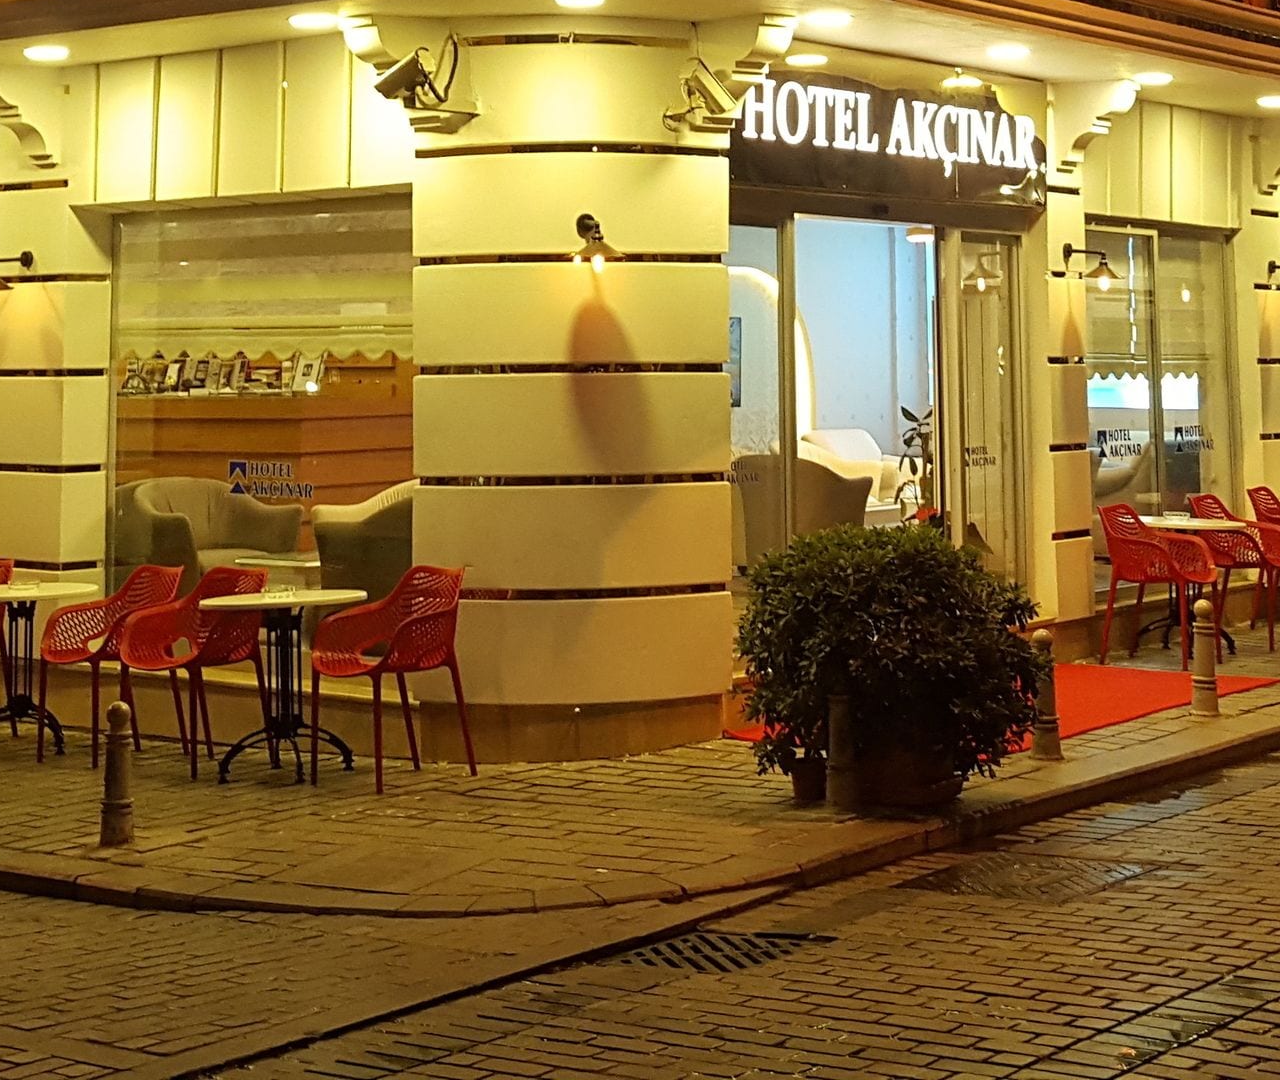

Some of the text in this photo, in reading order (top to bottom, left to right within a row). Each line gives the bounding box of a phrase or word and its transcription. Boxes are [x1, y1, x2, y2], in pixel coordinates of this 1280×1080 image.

[742, 78, 1039, 177] HOTEL AKÇINAR
[1108, 429, 1131, 441] HOTEL
[1184, 425, 1204, 437] HOTEL
[1110, 443, 1142, 460] AKÇINAR
[250, 461, 293, 478] HOTEL
[250, 479, 314, 499] AKÇINAR
